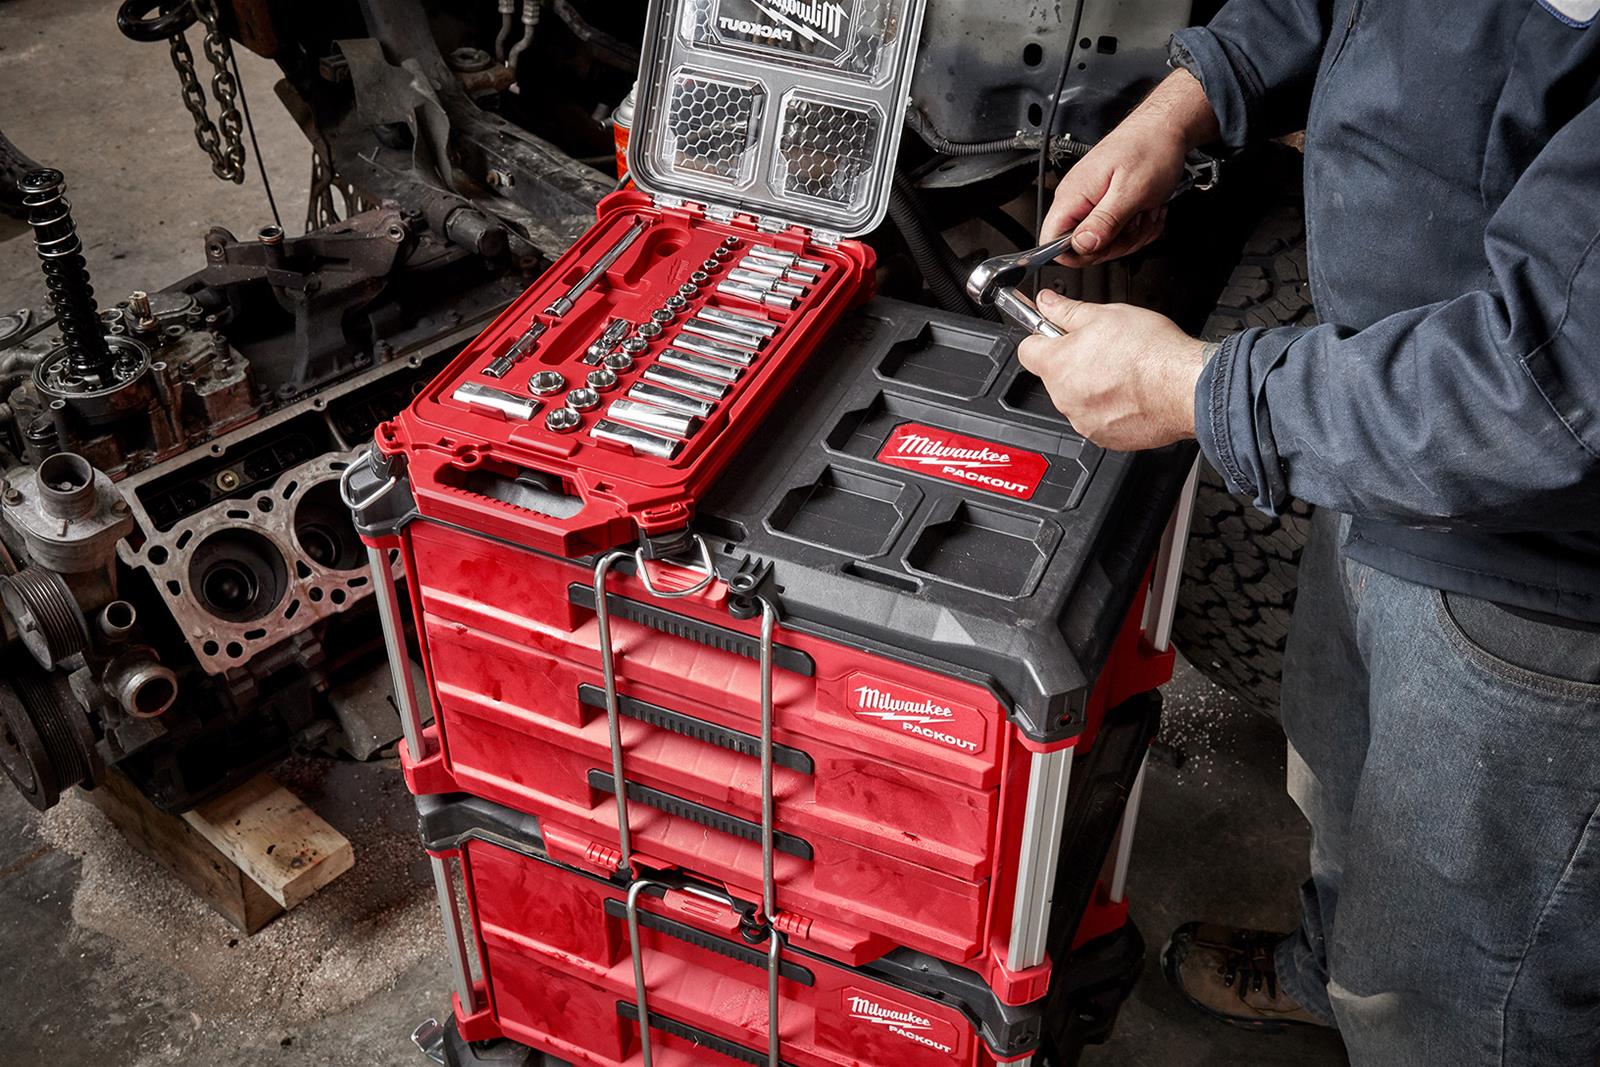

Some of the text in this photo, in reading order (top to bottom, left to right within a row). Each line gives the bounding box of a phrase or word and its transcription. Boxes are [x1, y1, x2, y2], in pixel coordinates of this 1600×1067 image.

[896, 434, 1011, 463] Milwaukee
[942, 466, 1028, 493] PACKOUT
[854, 686, 953, 717] Milwaukee
[902, 722, 976, 751] PACKOUT
[847, 996, 931, 1026] Milwaukee
[888, 1025, 951, 1053] PACKOUT
